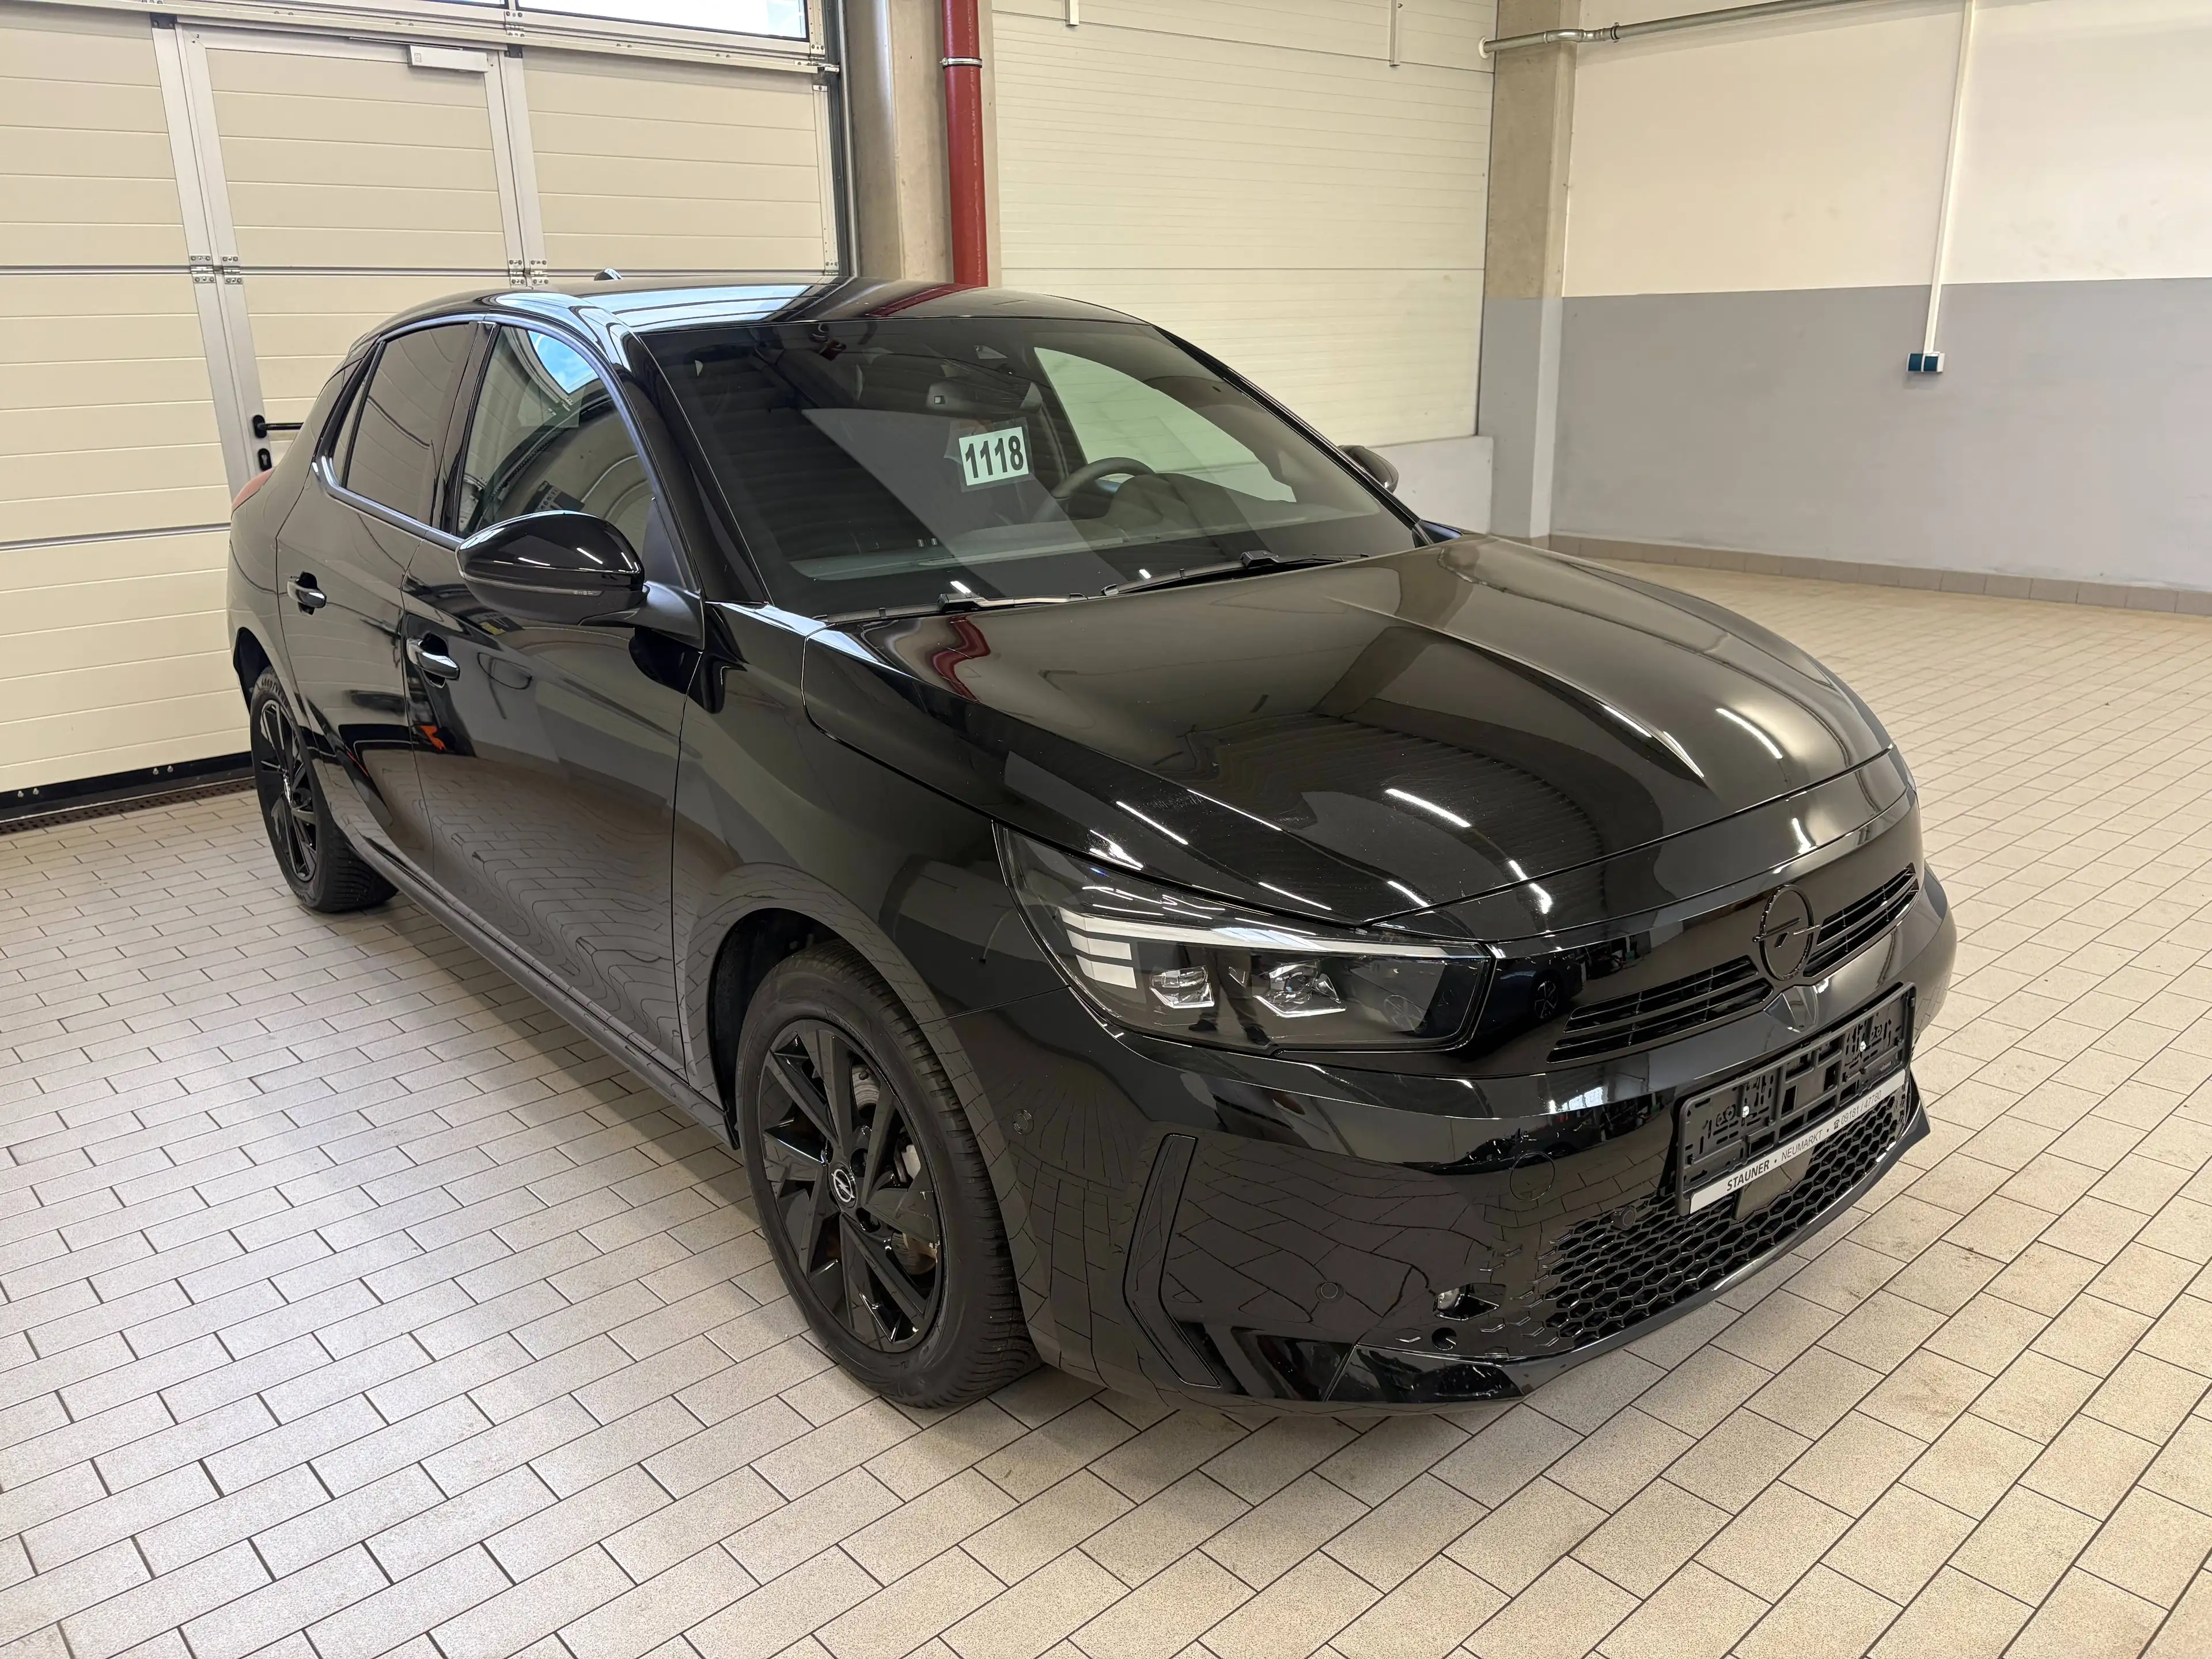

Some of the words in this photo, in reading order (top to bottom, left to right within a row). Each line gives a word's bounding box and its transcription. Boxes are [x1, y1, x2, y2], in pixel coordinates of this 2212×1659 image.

[965, 435, 1024, 479] 1118
[1726, 1159, 1770, 1192] STAUNER
[1781, 1129, 1823, 1161] NEUMARKT
[1840, 1105, 1859, 1124] 09181
[1864, 1090, 1881, 1108] 47780
